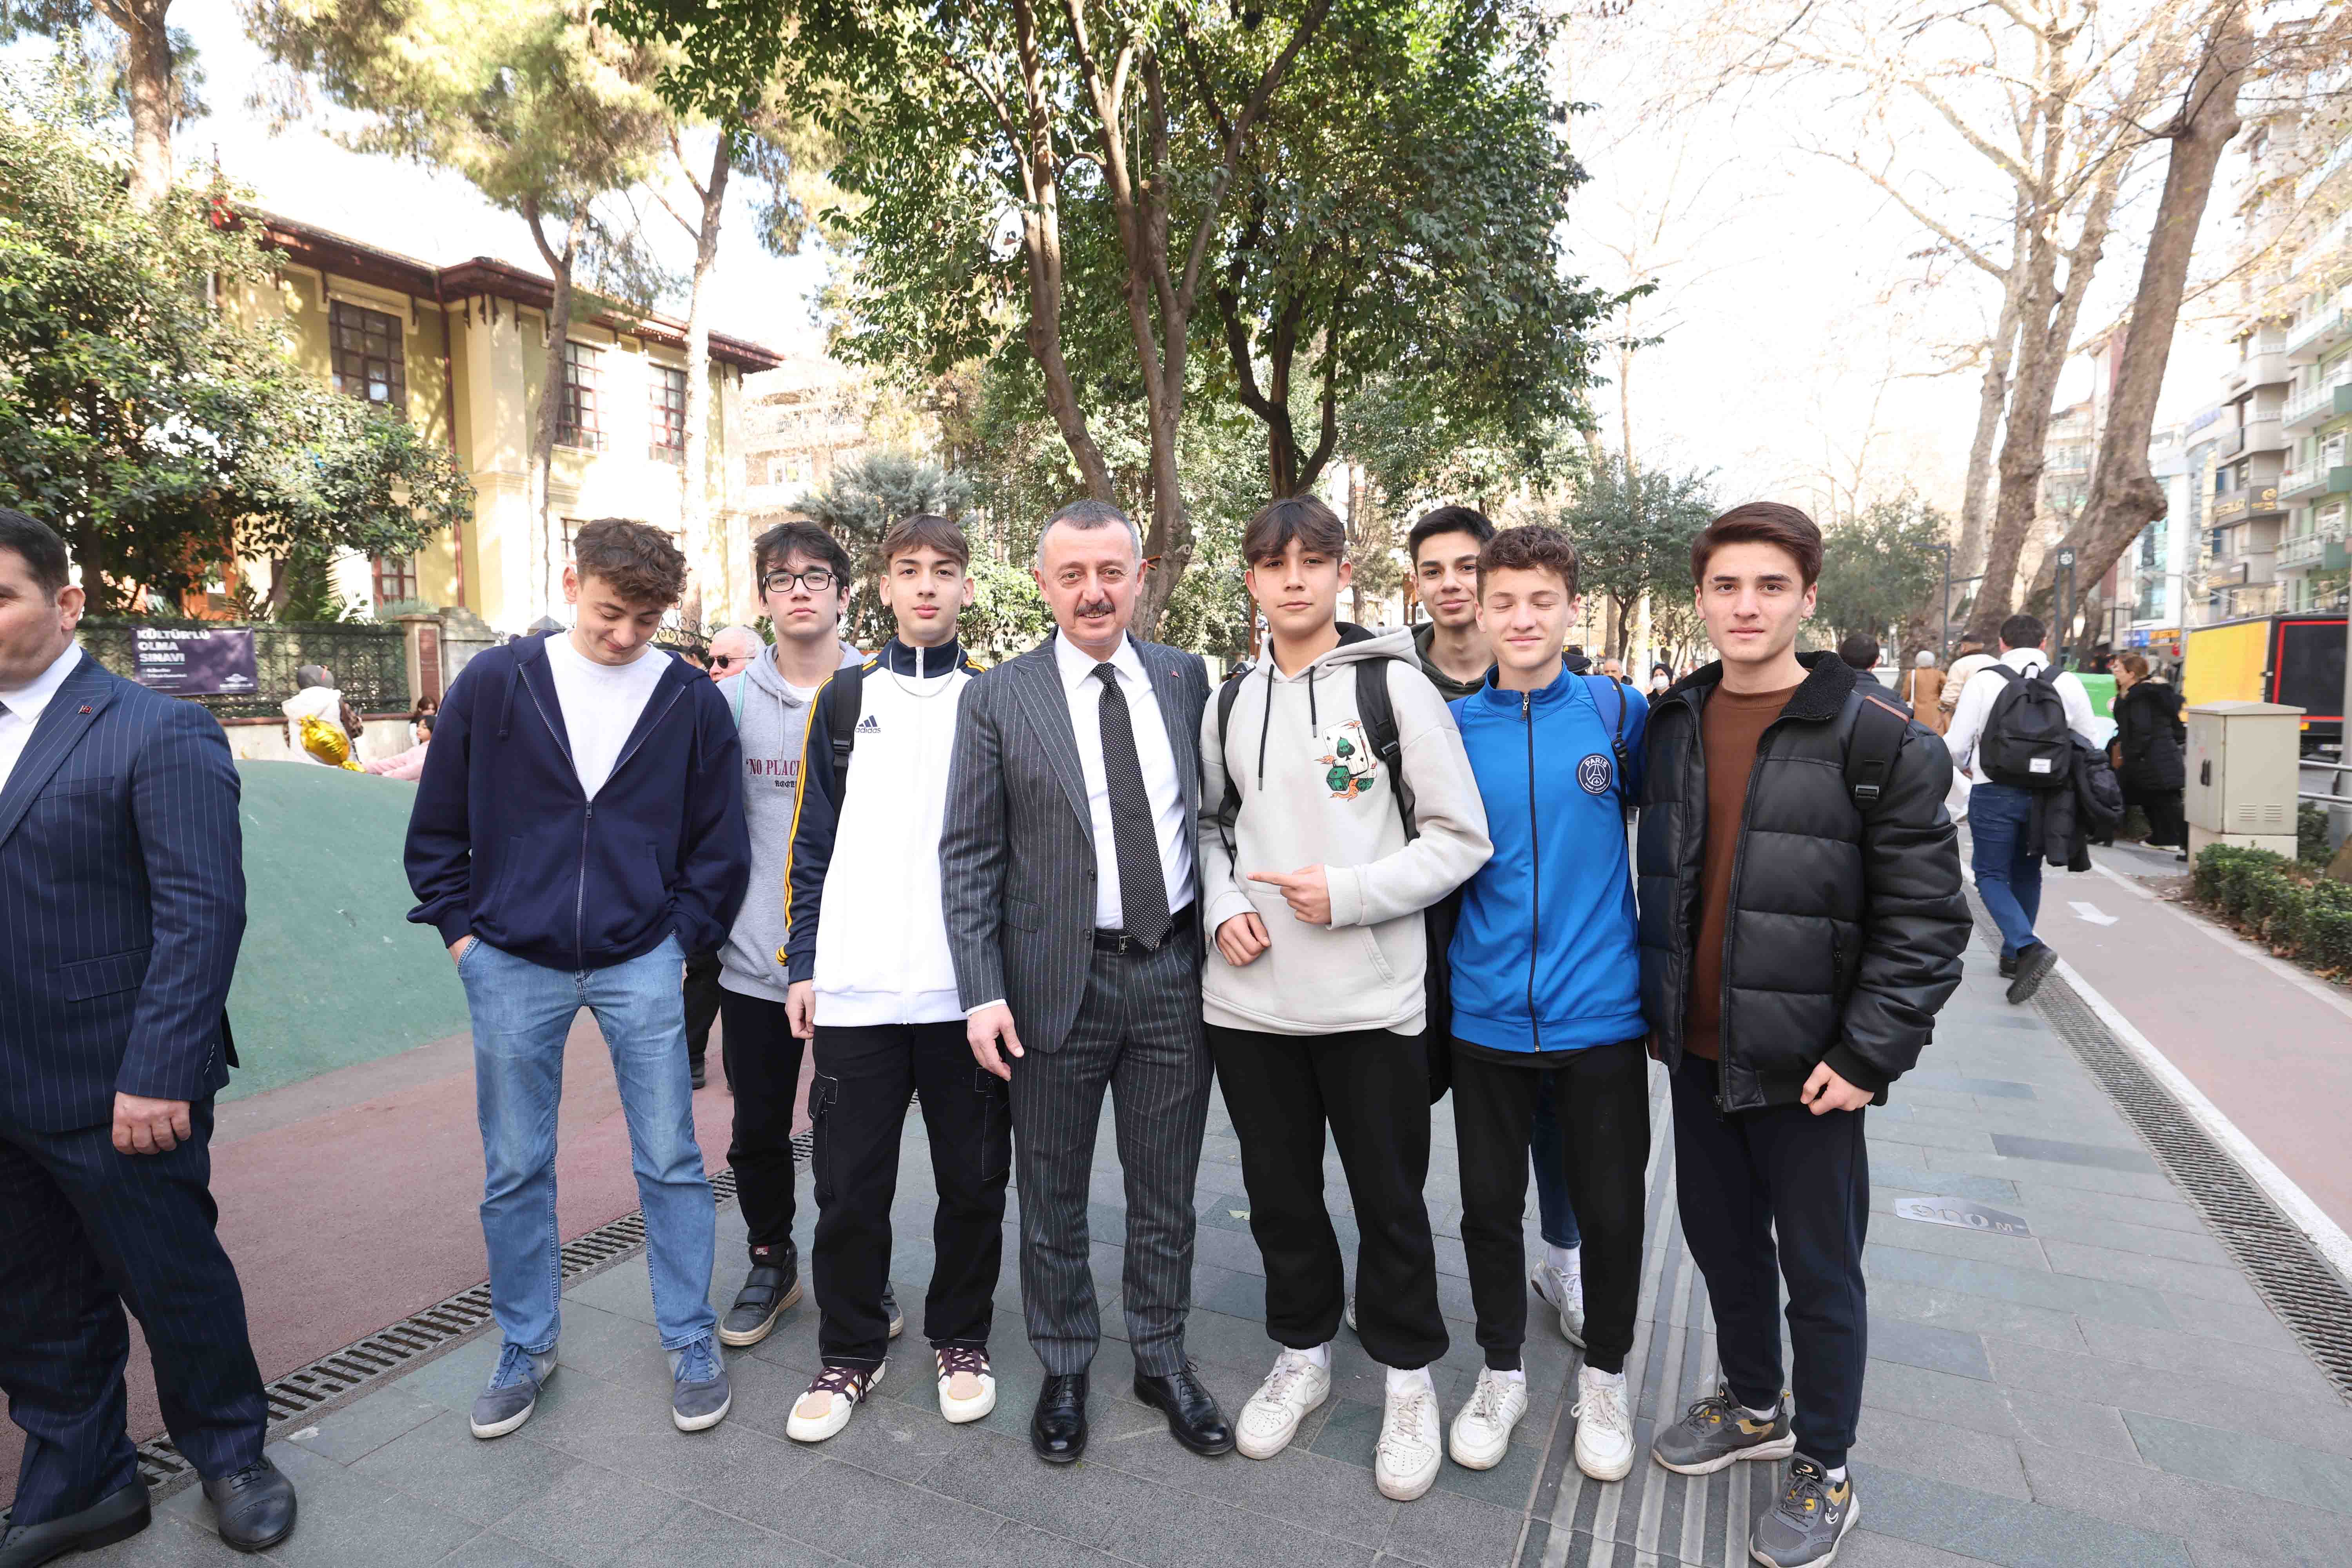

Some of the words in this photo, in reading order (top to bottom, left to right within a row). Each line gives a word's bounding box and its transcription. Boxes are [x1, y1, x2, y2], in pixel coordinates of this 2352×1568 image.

[138, 641, 179, 651] OLMA
[139, 653, 185, 662] SINAVI
[1585, 758, 1607, 768] PARIS
[1994, 1221, 2014, 1232] M
